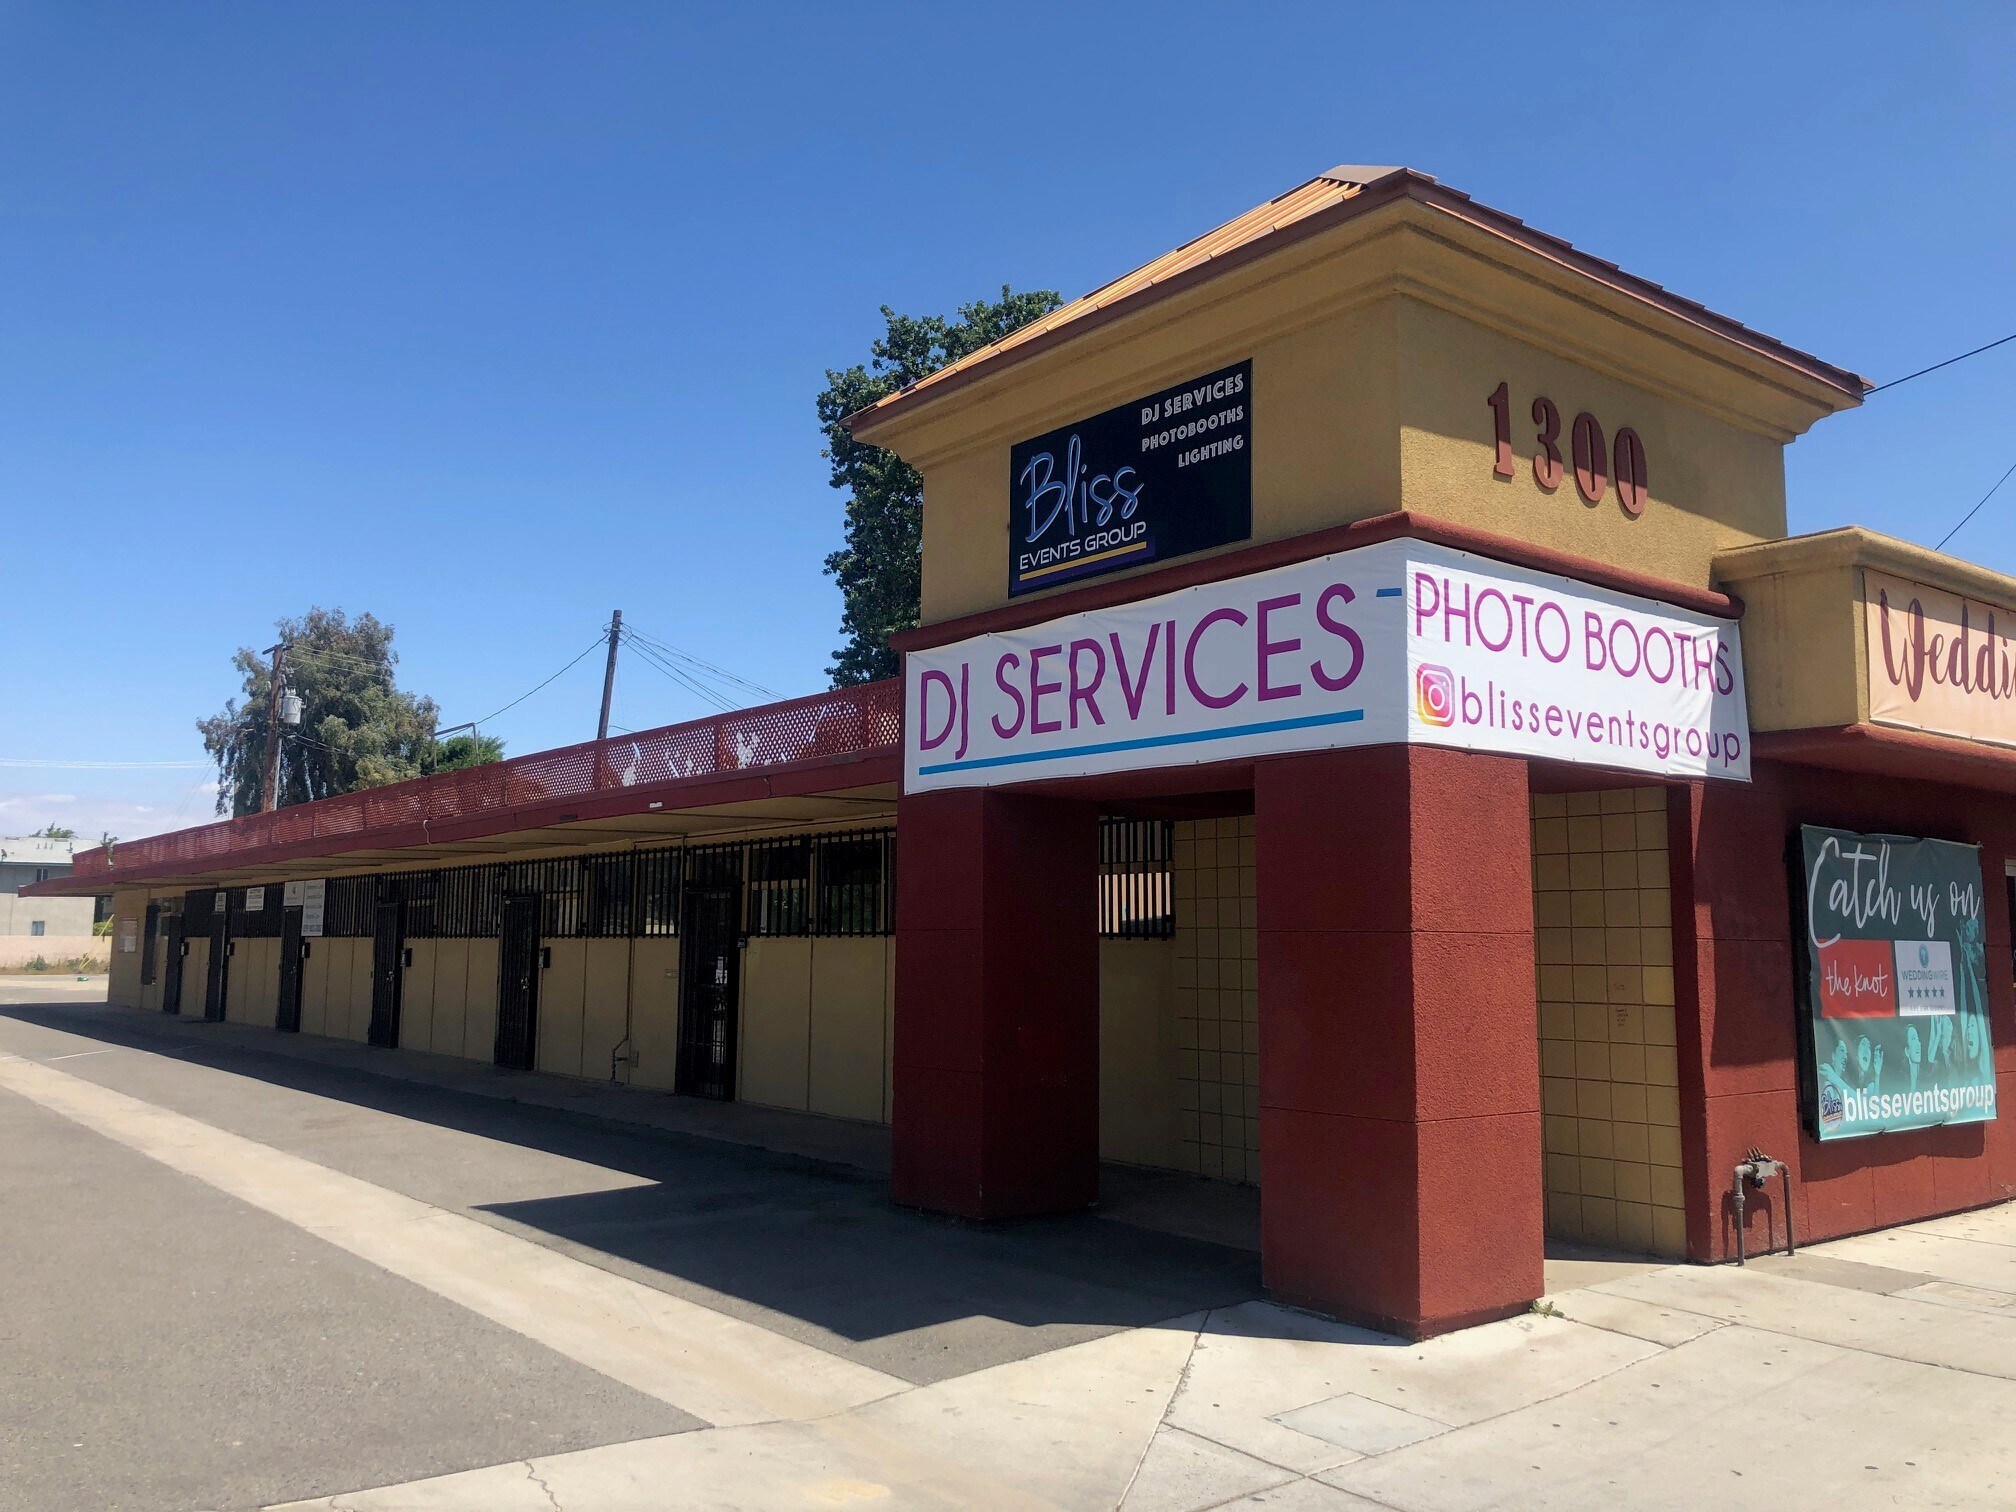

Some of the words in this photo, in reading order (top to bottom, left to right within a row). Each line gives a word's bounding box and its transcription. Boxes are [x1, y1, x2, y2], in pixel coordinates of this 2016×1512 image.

[1141, 403, 1161, 426] DJ
[1164, 373, 1244, 418] SERVICES
[1141, 405, 1244, 452] PHOTOBOOTHS
[1020, 433, 1145, 543] Bliss
[1178, 434, 1244, 468] LIGHTING
[1487, 381, 1648, 515] 1300
[1019, 539, 1081, 570] EVENTS
[1084, 521, 1147, 551] GROUP
[920, 662, 969, 760] DJ
[991, 583, 1365, 740] SERVICES
[1415, 572, 1571, 664] PHOTO
[1584, 610, 1735, 696] BOOTHS
[1880, 588, 2016, 702] Weddi
[1461, 676, 1741, 768] blisseventsgroup
[1809, 836, 1902, 948] Catch
[1910, 882, 1940, 938] us
[1949, 881, 1980, 920] on
[1825, 959, 1852, 996] the
[1853, 963, 1888, 998] knot
[1843, 1083, 1994, 1122] blisseventsgroup
